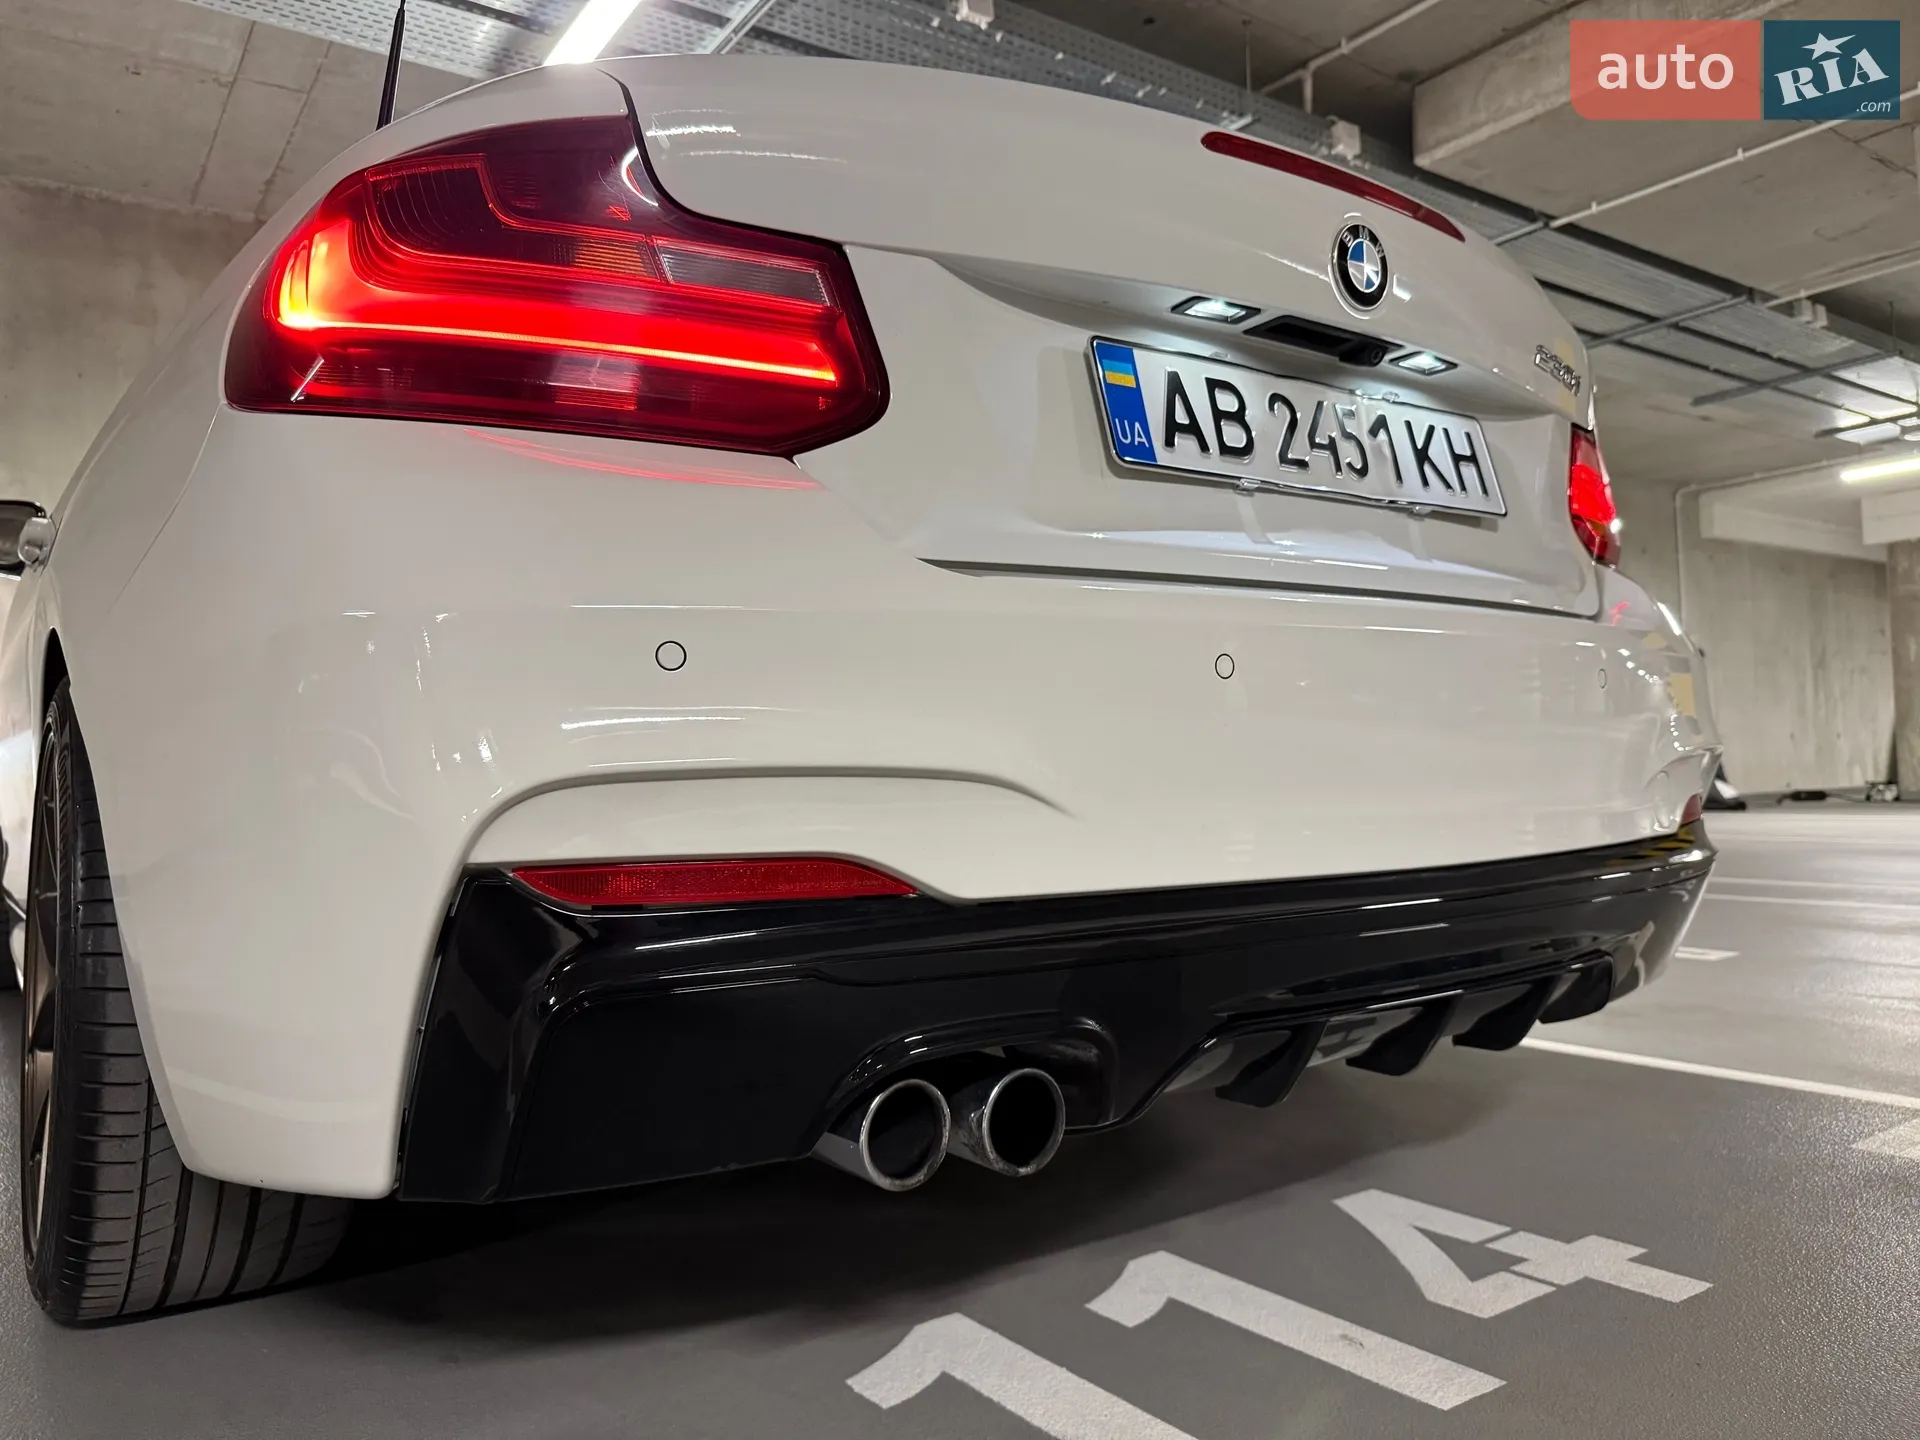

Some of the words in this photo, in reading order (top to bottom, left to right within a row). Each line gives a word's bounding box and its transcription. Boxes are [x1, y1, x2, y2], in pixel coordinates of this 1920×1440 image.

[1341, 225, 1385, 259] BMW
[1115, 417, 1150, 448] UA
[1163, 368, 1256, 461] AB
[1267, 392, 1403, 488] 2451
[1403, 419, 1489, 499] KH
